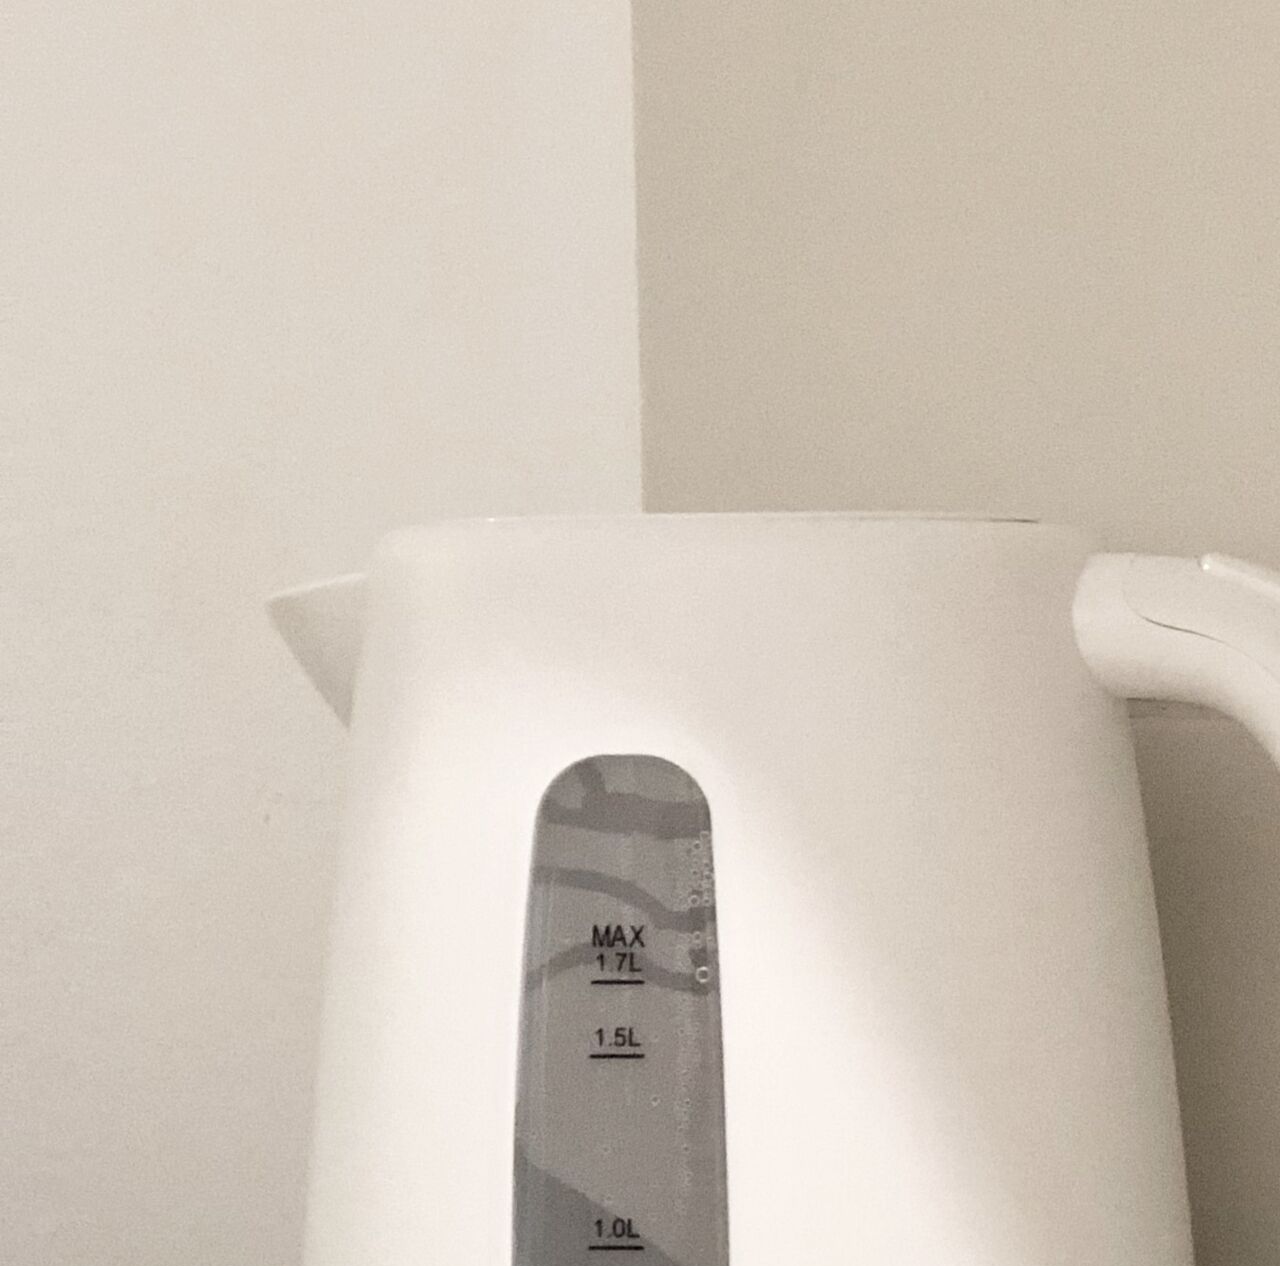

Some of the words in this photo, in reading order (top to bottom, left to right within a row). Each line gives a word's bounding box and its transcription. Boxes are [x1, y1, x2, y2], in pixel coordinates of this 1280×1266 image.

[592, 924, 645, 948] MAX
[595, 1027, 641, 1047] 1.5L
[594, 1218, 640, 1238] 1.0L
